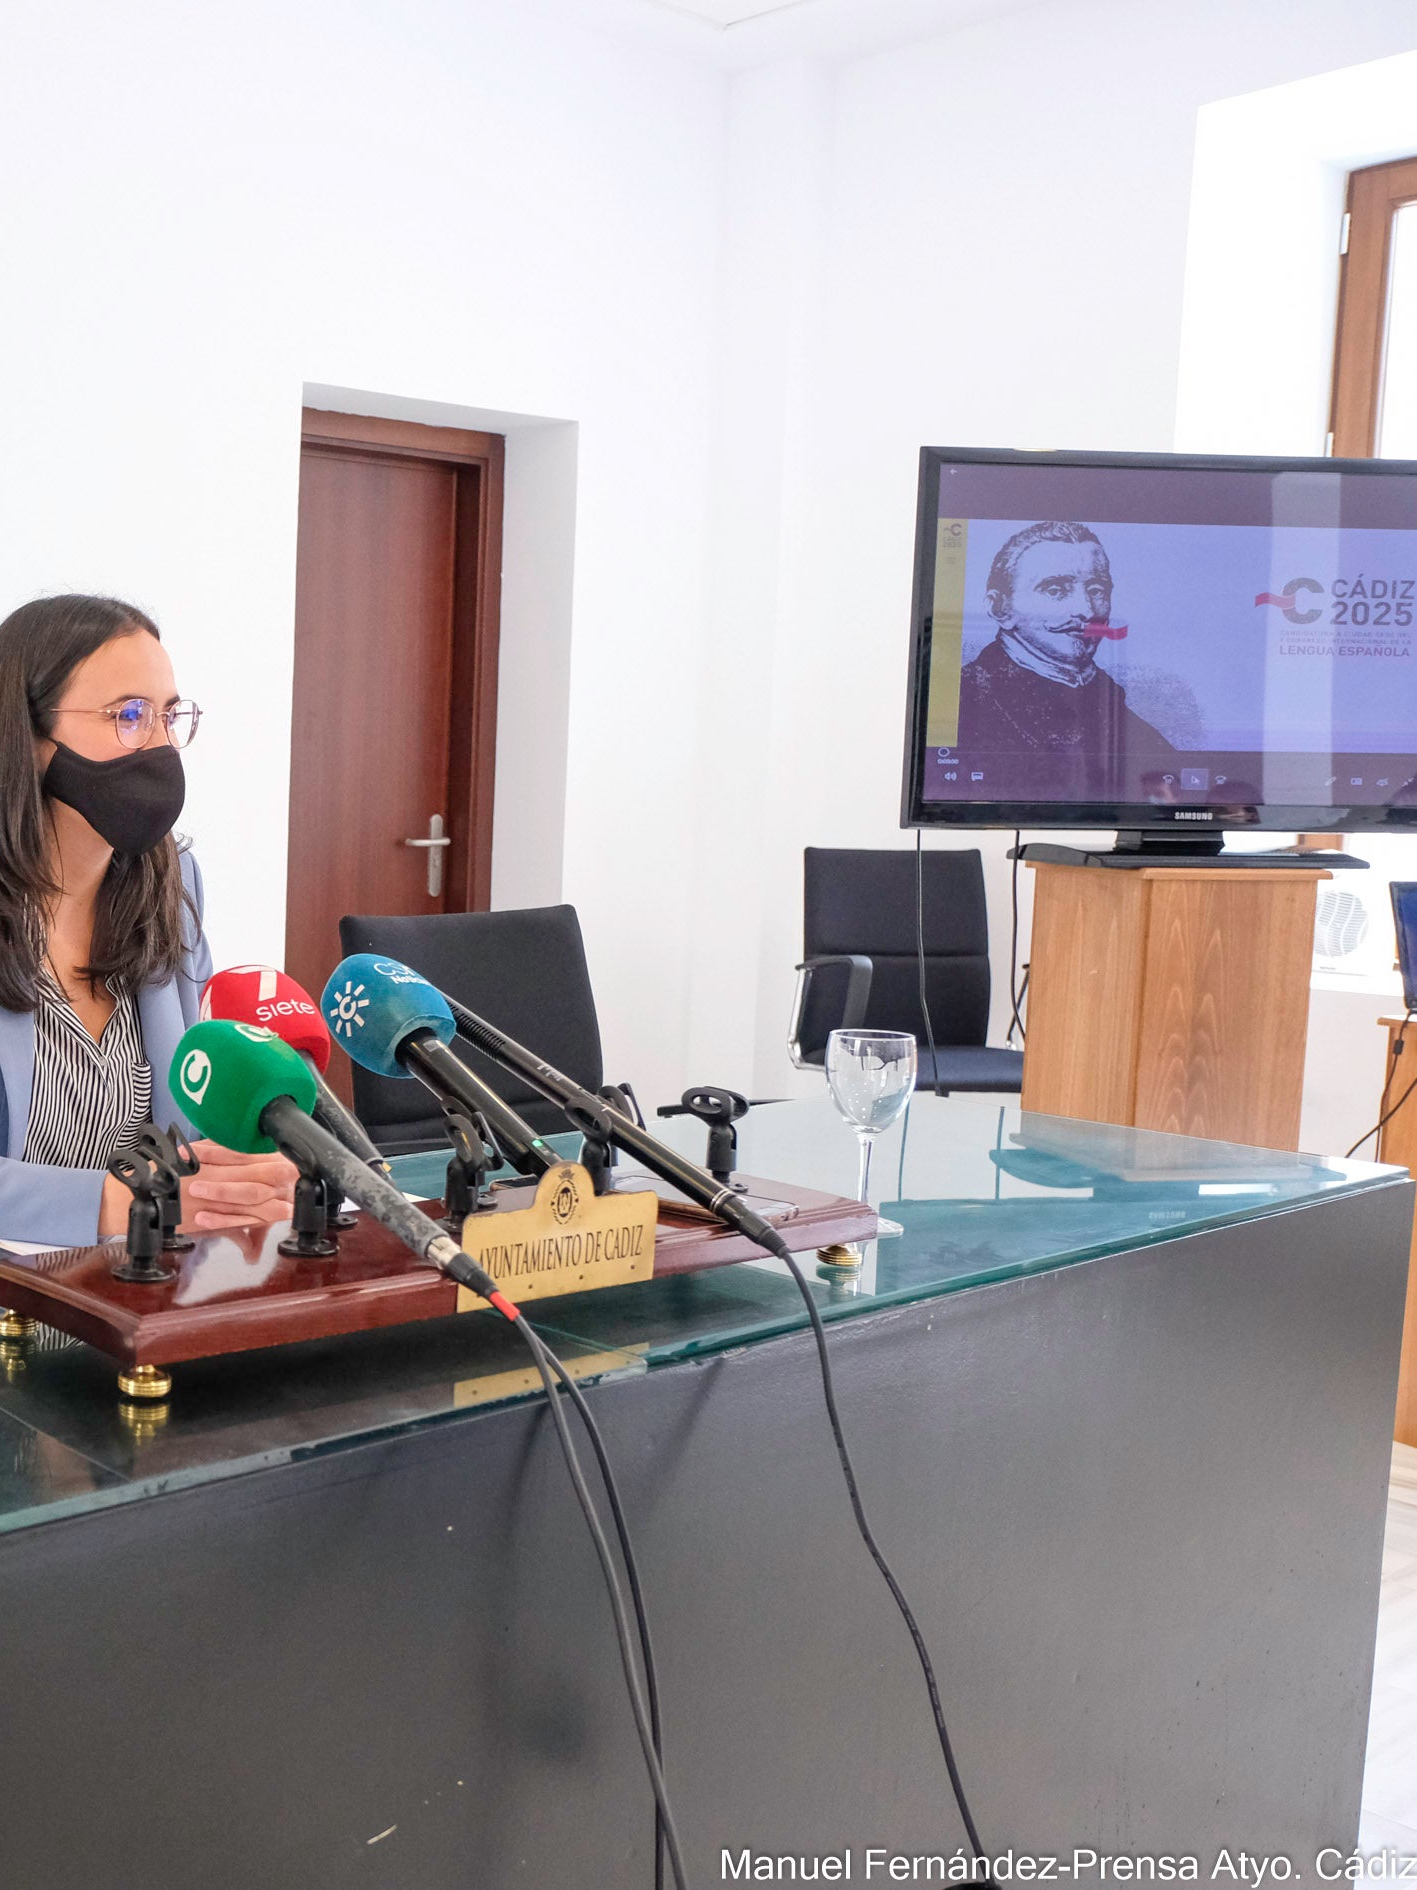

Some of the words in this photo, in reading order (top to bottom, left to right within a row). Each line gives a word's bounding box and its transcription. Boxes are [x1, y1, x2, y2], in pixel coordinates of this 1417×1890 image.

[1331, 573, 1415, 600] CÁDIZ
[1330, 601, 1413, 626] 2025
[1279, 645, 1334, 656] LENGUA
[1339, 645, 1410, 657] ESPAÑOLA
[1174, 812, 1213, 820] SAMSUNG
[256, 999, 316, 1022] siete
[585, 1231, 602, 1264] DE
[604, 1225, 643, 1261] CADIZ
